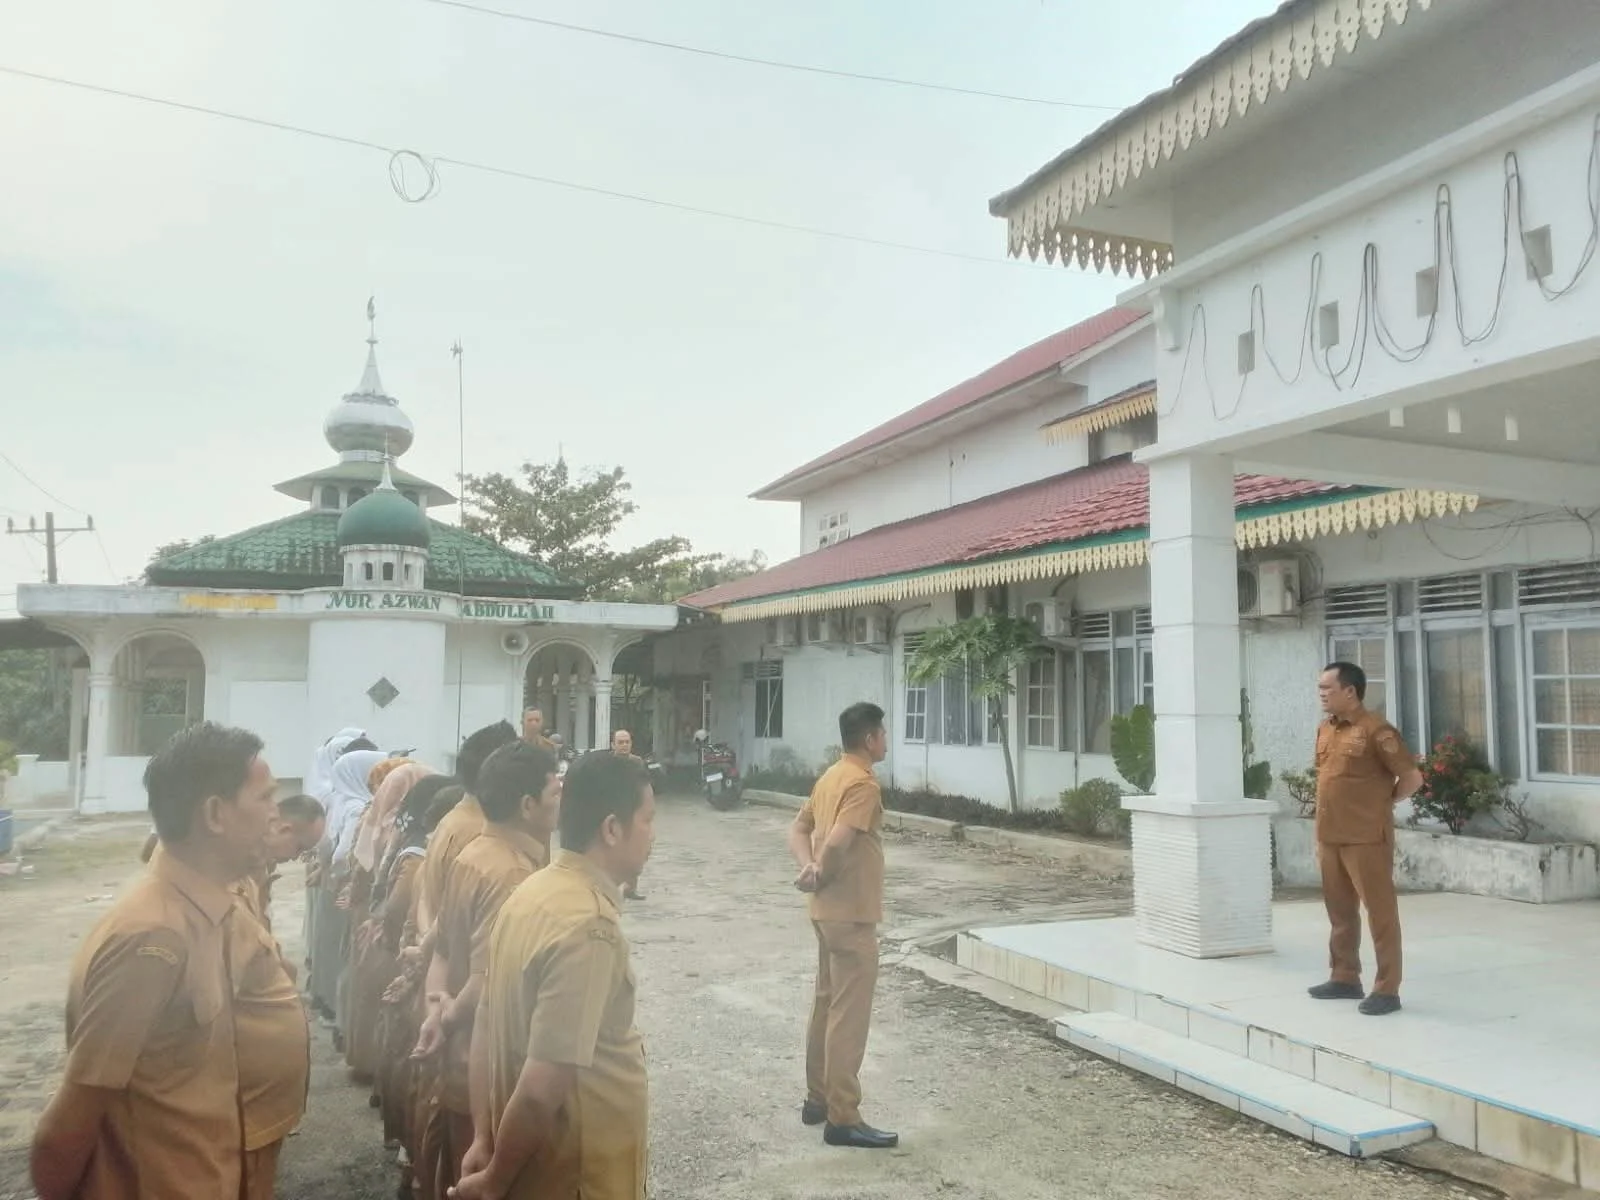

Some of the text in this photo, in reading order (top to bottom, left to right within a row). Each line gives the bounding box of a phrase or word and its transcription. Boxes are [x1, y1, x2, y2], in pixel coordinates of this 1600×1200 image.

[326, 591, 554, 619] NUR AZWAN ABDULLAH
